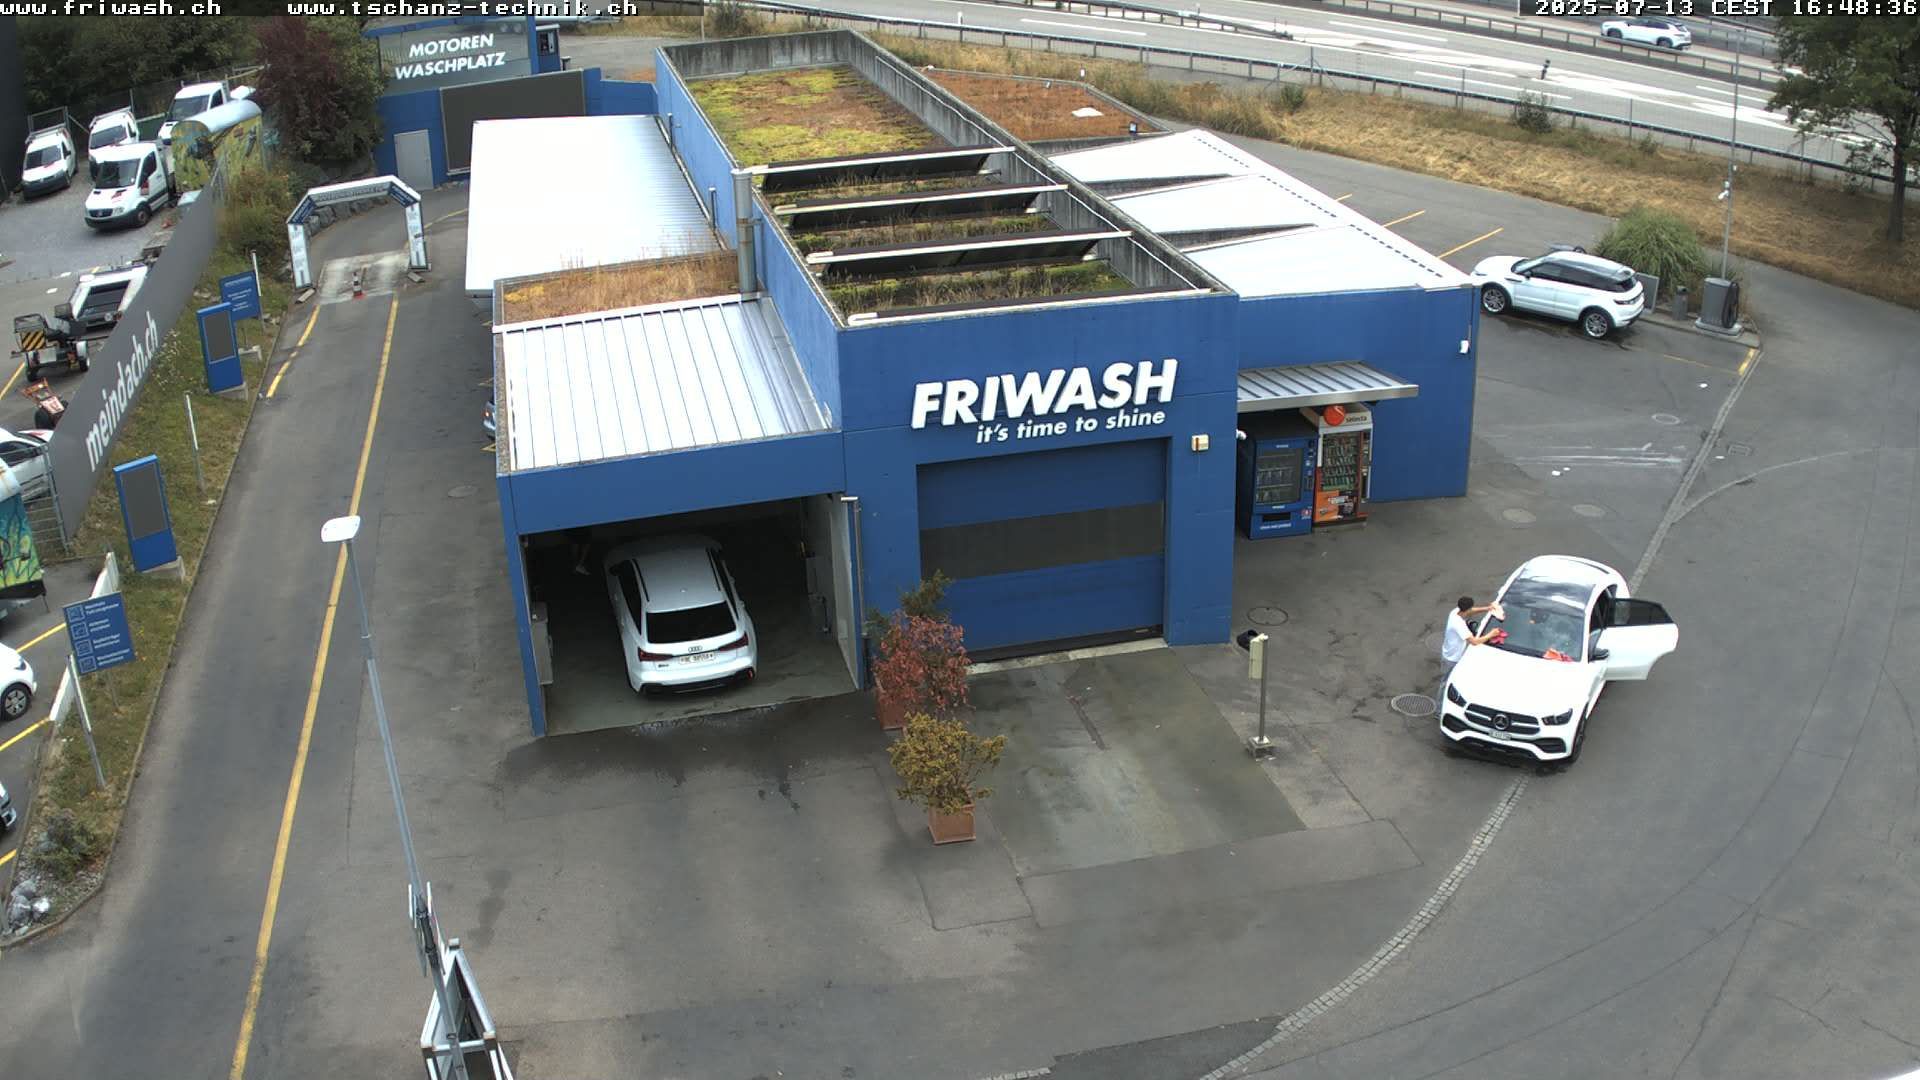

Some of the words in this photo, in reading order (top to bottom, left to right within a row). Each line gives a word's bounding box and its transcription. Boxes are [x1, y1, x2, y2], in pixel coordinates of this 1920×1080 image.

[408, 33, 495, 58] MOTOREN
[395, 51, 506, 80] WASCHPLATZ
[85, 310, 160, 473] meindach.ch
[911, 358, 1179, 430] FRIWASH
[976, 423, 1009, 444] it's
[1017, 419, 1067, 440] time
[1075, 413, 1098, 433] to
[1105, 407, 1166, 430] shine
